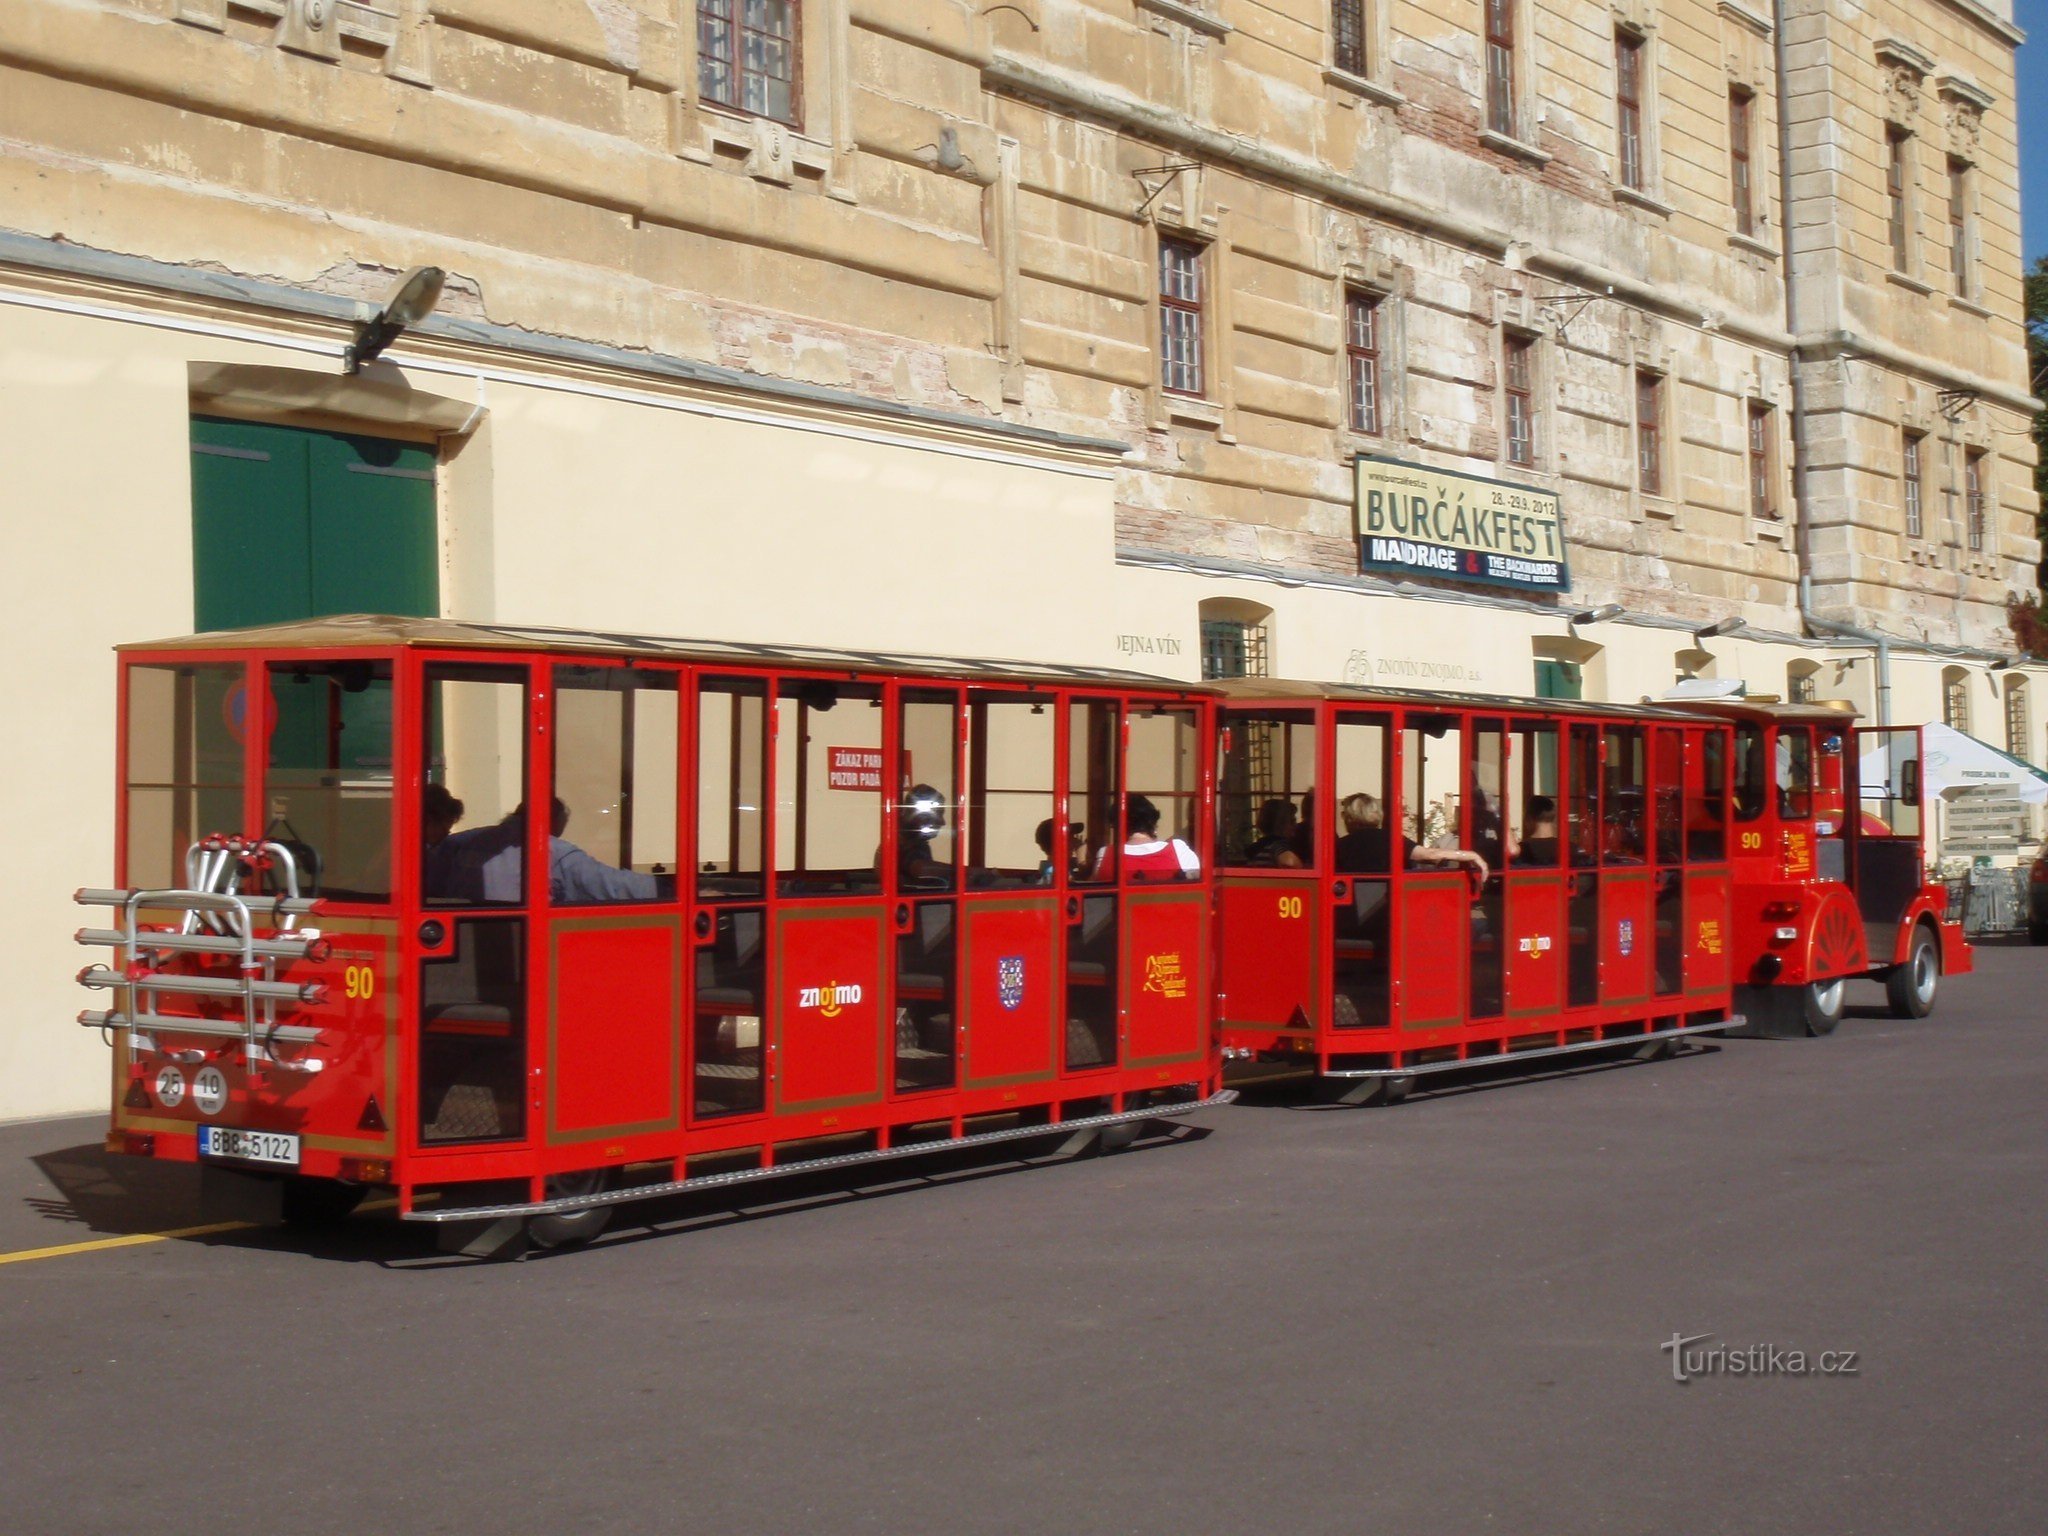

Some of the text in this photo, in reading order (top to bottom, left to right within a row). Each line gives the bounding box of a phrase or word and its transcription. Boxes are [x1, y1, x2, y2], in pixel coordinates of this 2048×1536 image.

[1532, 499, 1556, 516] 2012
[1367, 485, 1556, 557] BURČÁKFEST
[1372, 538, 1457, 572] MANDRAGE
[1487, 555, 1506, 570] THE
[1505, 558, 1558, 577] BACKWARDS
[1155, 633, 1182, 656] VÍN
[1376, 657, 1419, 676] ZNOVÍN
[835, 749, 862, 768] ZÁKAZ
[830, 771, 858, 786] POZOR
[1742, 832, 1761, 849] 90
[1279, 896, 1302, 919] 90
[345, 965, 374, 1000] 90
[799, 980, 862, 1011] znojmo
[160, 1073, 181, 1095] 25
[200, 1074, 220, 1095] 10
[212, 1130, 291, 1160] 8B8 5122
